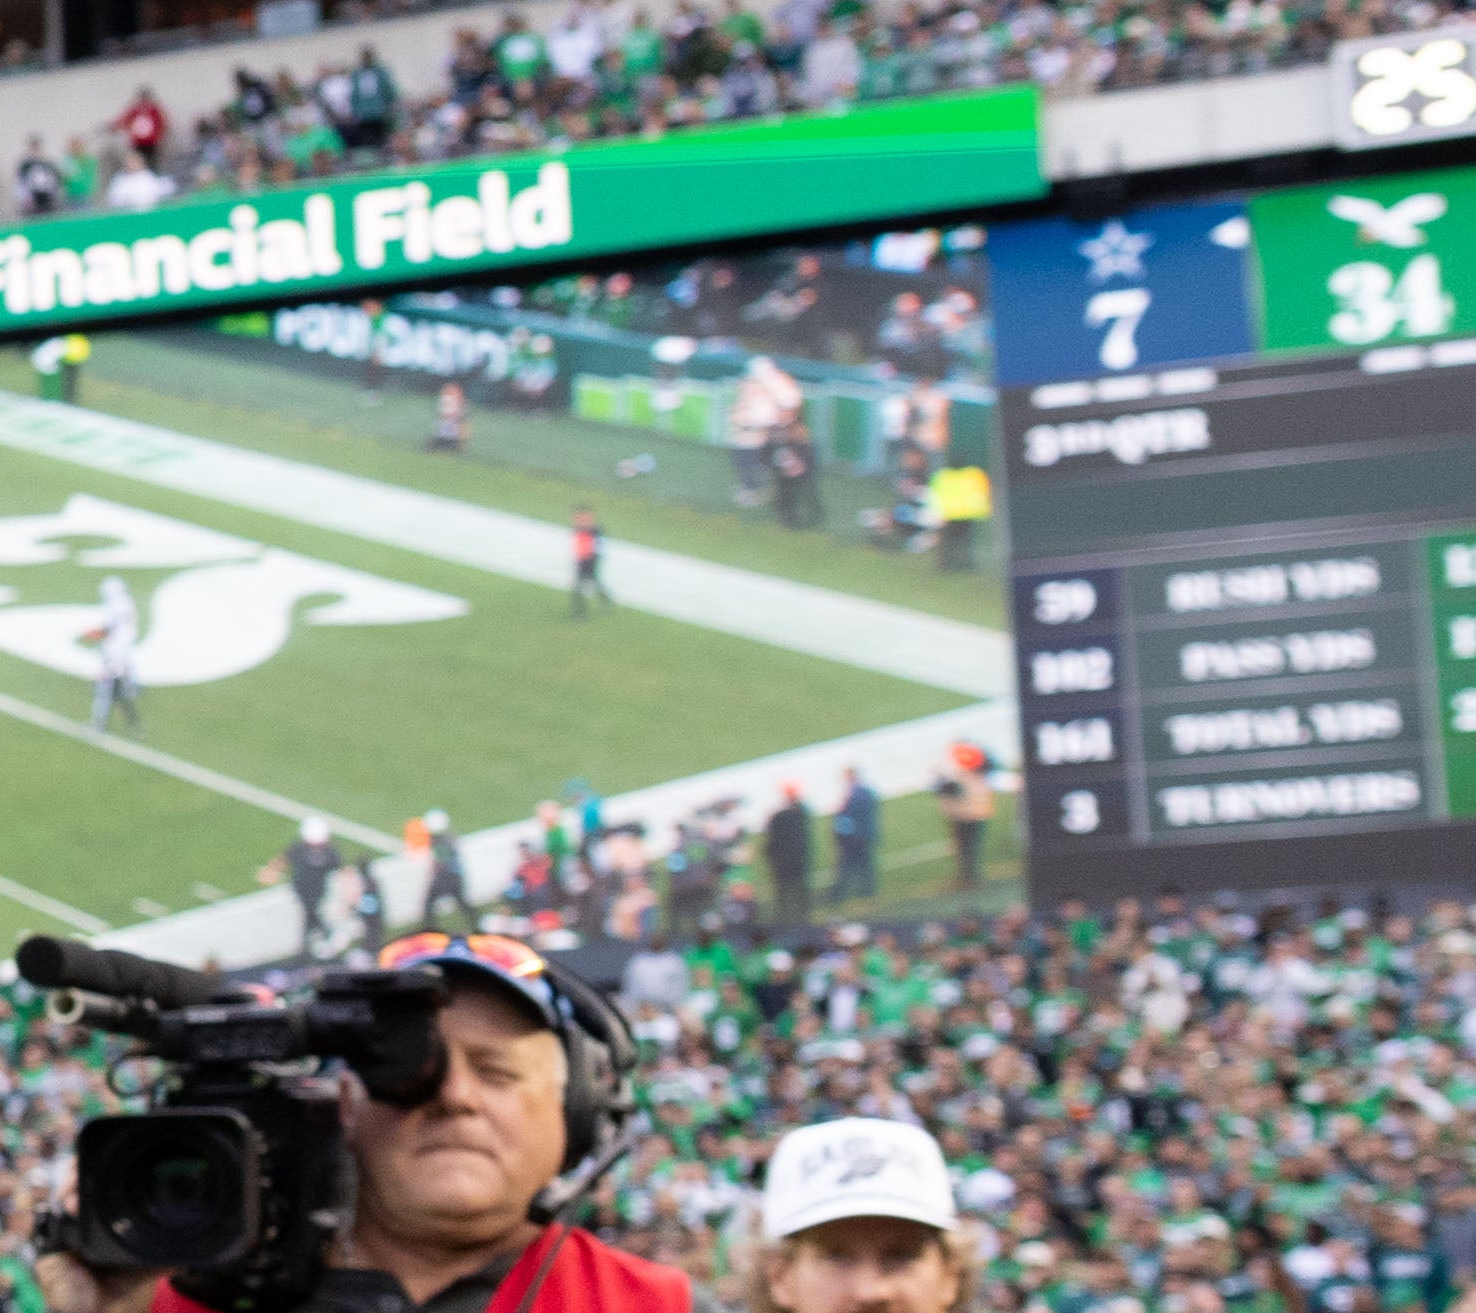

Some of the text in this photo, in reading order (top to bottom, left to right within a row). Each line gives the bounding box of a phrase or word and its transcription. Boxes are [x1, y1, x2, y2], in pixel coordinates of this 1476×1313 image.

[354, 162, 573, 270] Field
[1084, 288, 1151, 371] 7
[1327, 253, 1455, 345] 34
